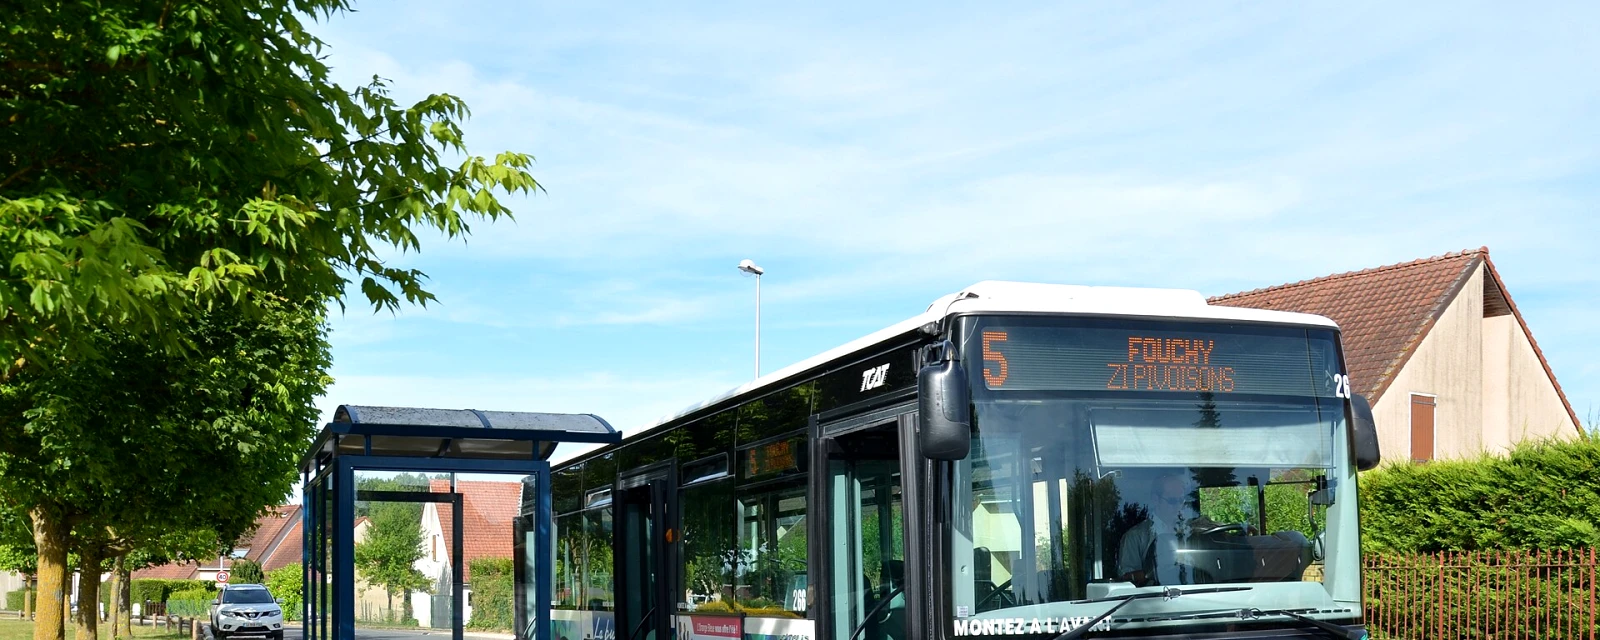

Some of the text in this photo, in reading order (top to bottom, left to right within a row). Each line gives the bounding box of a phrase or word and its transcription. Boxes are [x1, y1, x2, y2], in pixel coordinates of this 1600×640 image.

[982, 331, 1008, 386] 5
[1128, 337, 1214, 364] FOUCHY
[859, 363, 890, 392] TCAT
[1107, 363, 1235, 392] ZI PIVOISONS
[1333, 373, 1351, 399] 26
[792, 589, 807, 611] 266
[953, 617, 1025, 636] MONTEZ
[1029, 617, 1042, 634] A
